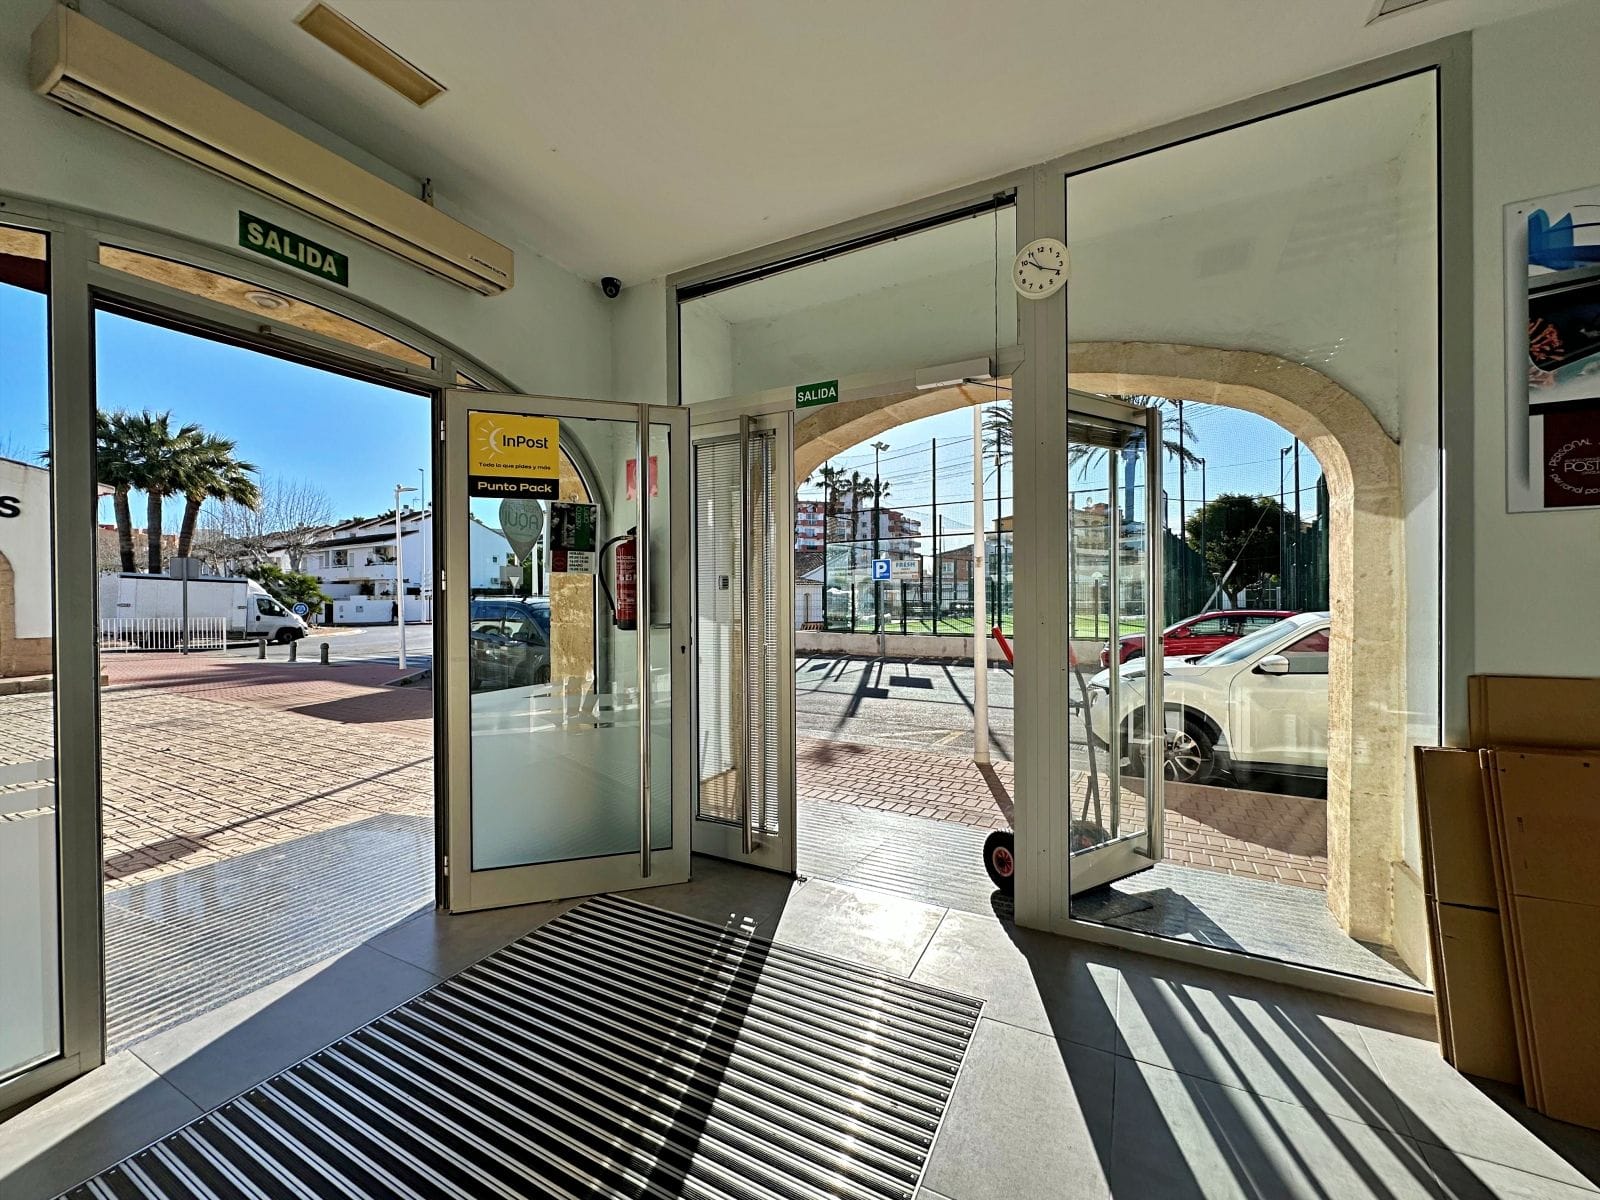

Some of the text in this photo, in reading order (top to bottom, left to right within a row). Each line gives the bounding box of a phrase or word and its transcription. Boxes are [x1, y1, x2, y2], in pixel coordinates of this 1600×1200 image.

[247, 222, 338, 277] SALIDA
[797, 386, 837, 402] SALIDA
[502, 434, 549, 449] InPost
[477, 481, 552, 493] Punto Pack
[875, 561, 888, 579] P
